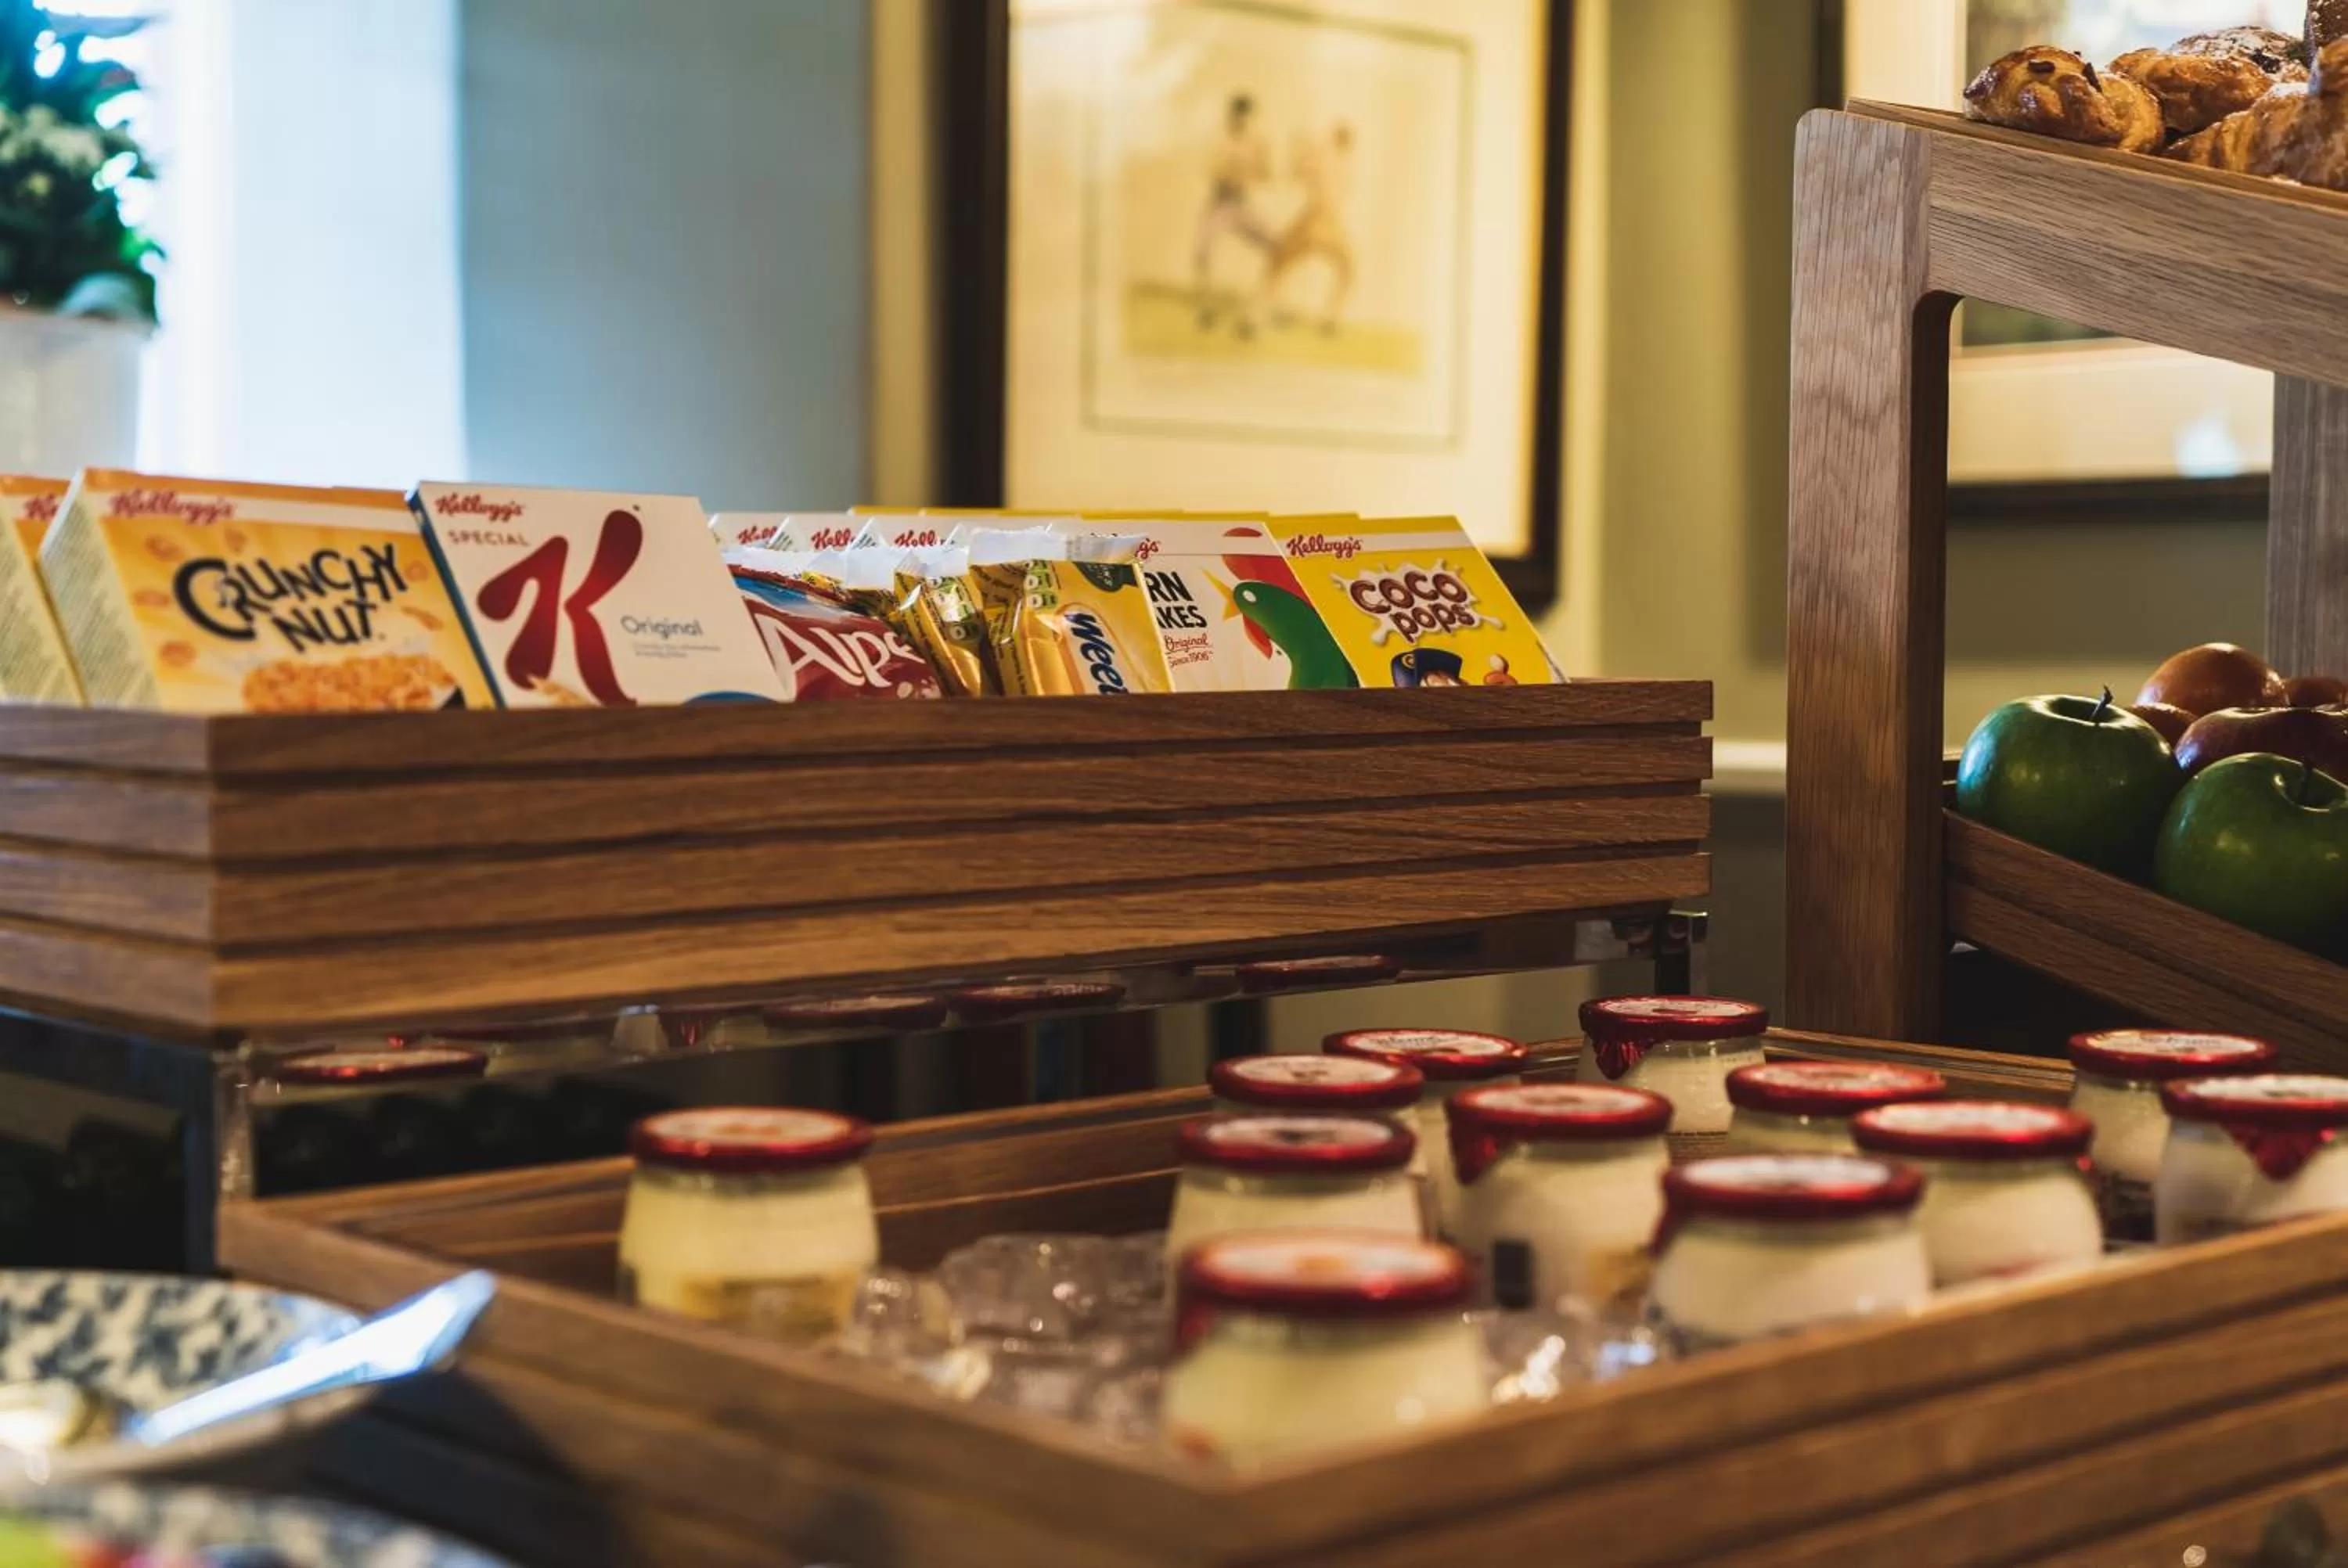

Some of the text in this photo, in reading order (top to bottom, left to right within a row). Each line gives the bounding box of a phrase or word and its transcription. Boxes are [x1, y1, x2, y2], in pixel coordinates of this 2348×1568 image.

[110, 488, 233, 525] Kellogg's
[435, 492, 522, 523] Kellogg's
[448, 530, 531, 547] SPECIAL
[738, 525, 777, 545] Kell
[811, 527, 854, 550] Kell
[1286, 534, 1361, 559] Kellogg's
[173, 543, 407, 642] CRUNCHY
[1143, 571, 1194, 602] RN
[476, 509, 643, 707] K
[271, 598, 378, 653] NUT
[620, 615, 704, 640] Original
[753, 611, 927, 703] Alpe
[1164, 633, 1209, 653] Original
